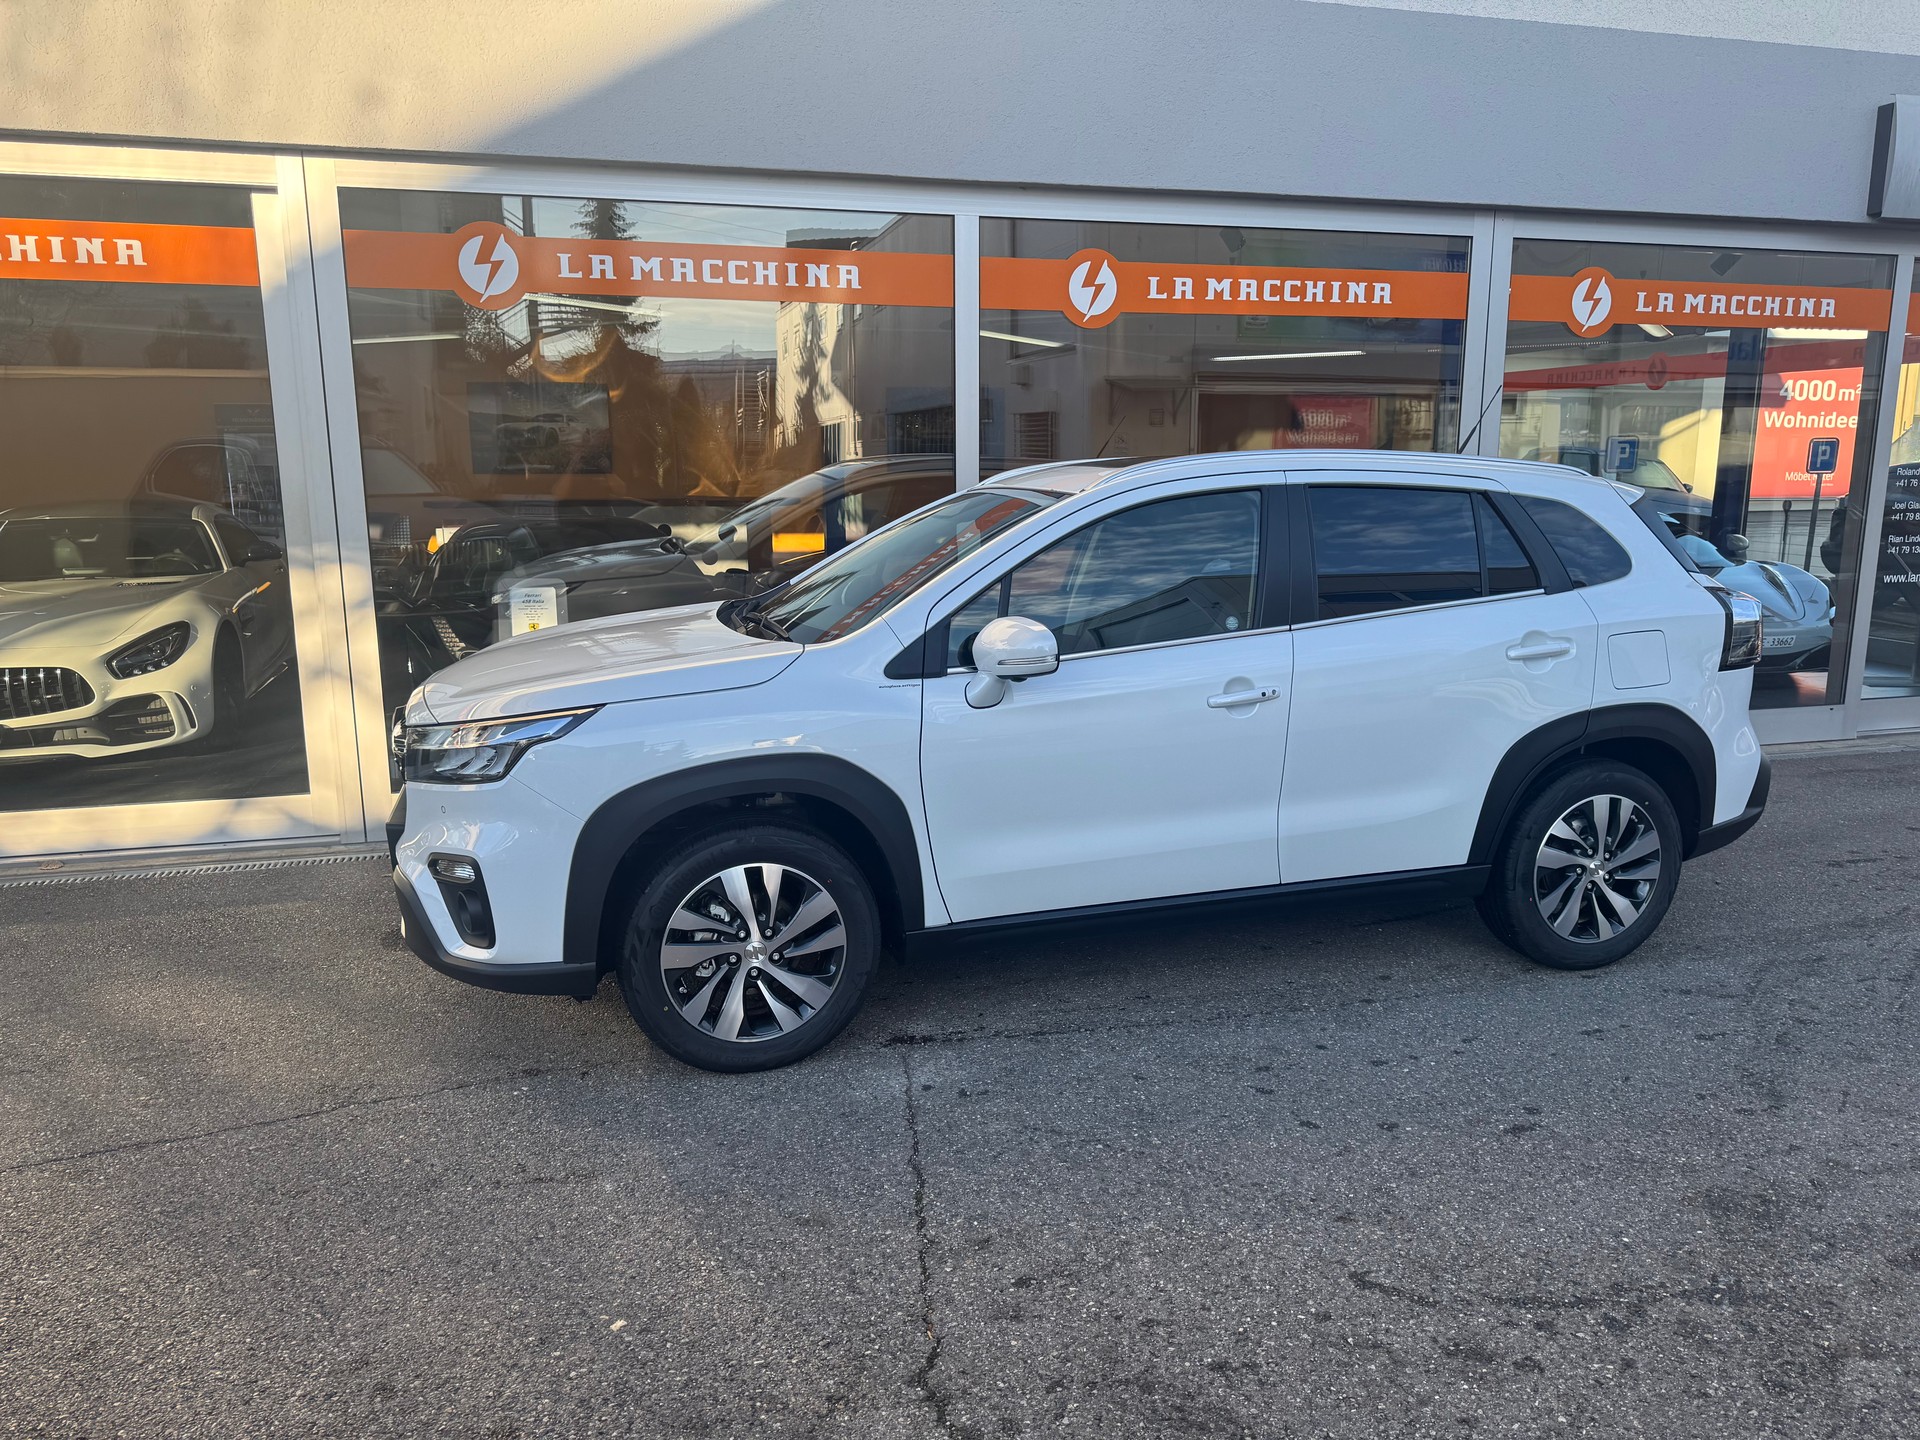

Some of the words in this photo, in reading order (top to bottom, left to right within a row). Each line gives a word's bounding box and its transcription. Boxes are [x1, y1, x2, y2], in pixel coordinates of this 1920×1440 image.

[0, 234, 148, 266] HINA
[557, 252, 617, 280] LA
[630, 256, 862, 290] MACCHINA
[1146, 276, 1195, 300] LA
[1205, 278, 1393, 304] MACCHINA
[1636, 291, 1674, 313] LA
[1683, 293, 1836, 318] MACCHINA
[1779, 379, 1837, 402] 4000
[1817, 445, 1830, 468] P
[1895, 478, 1907, 487] +41
[1909, 478, 1918, 487] 76
[1891, 501, 1906, 509] Joel
[1907, 501, 1920, 509] Gla
[1891, 512, 1903, 521] +41
[1905, 512, 1915, 521] 79
[1886, 546, 1899, 554] +41
[1901, 546, 1910, 554] 79
[1888, 534, 1903, 543] Rian
